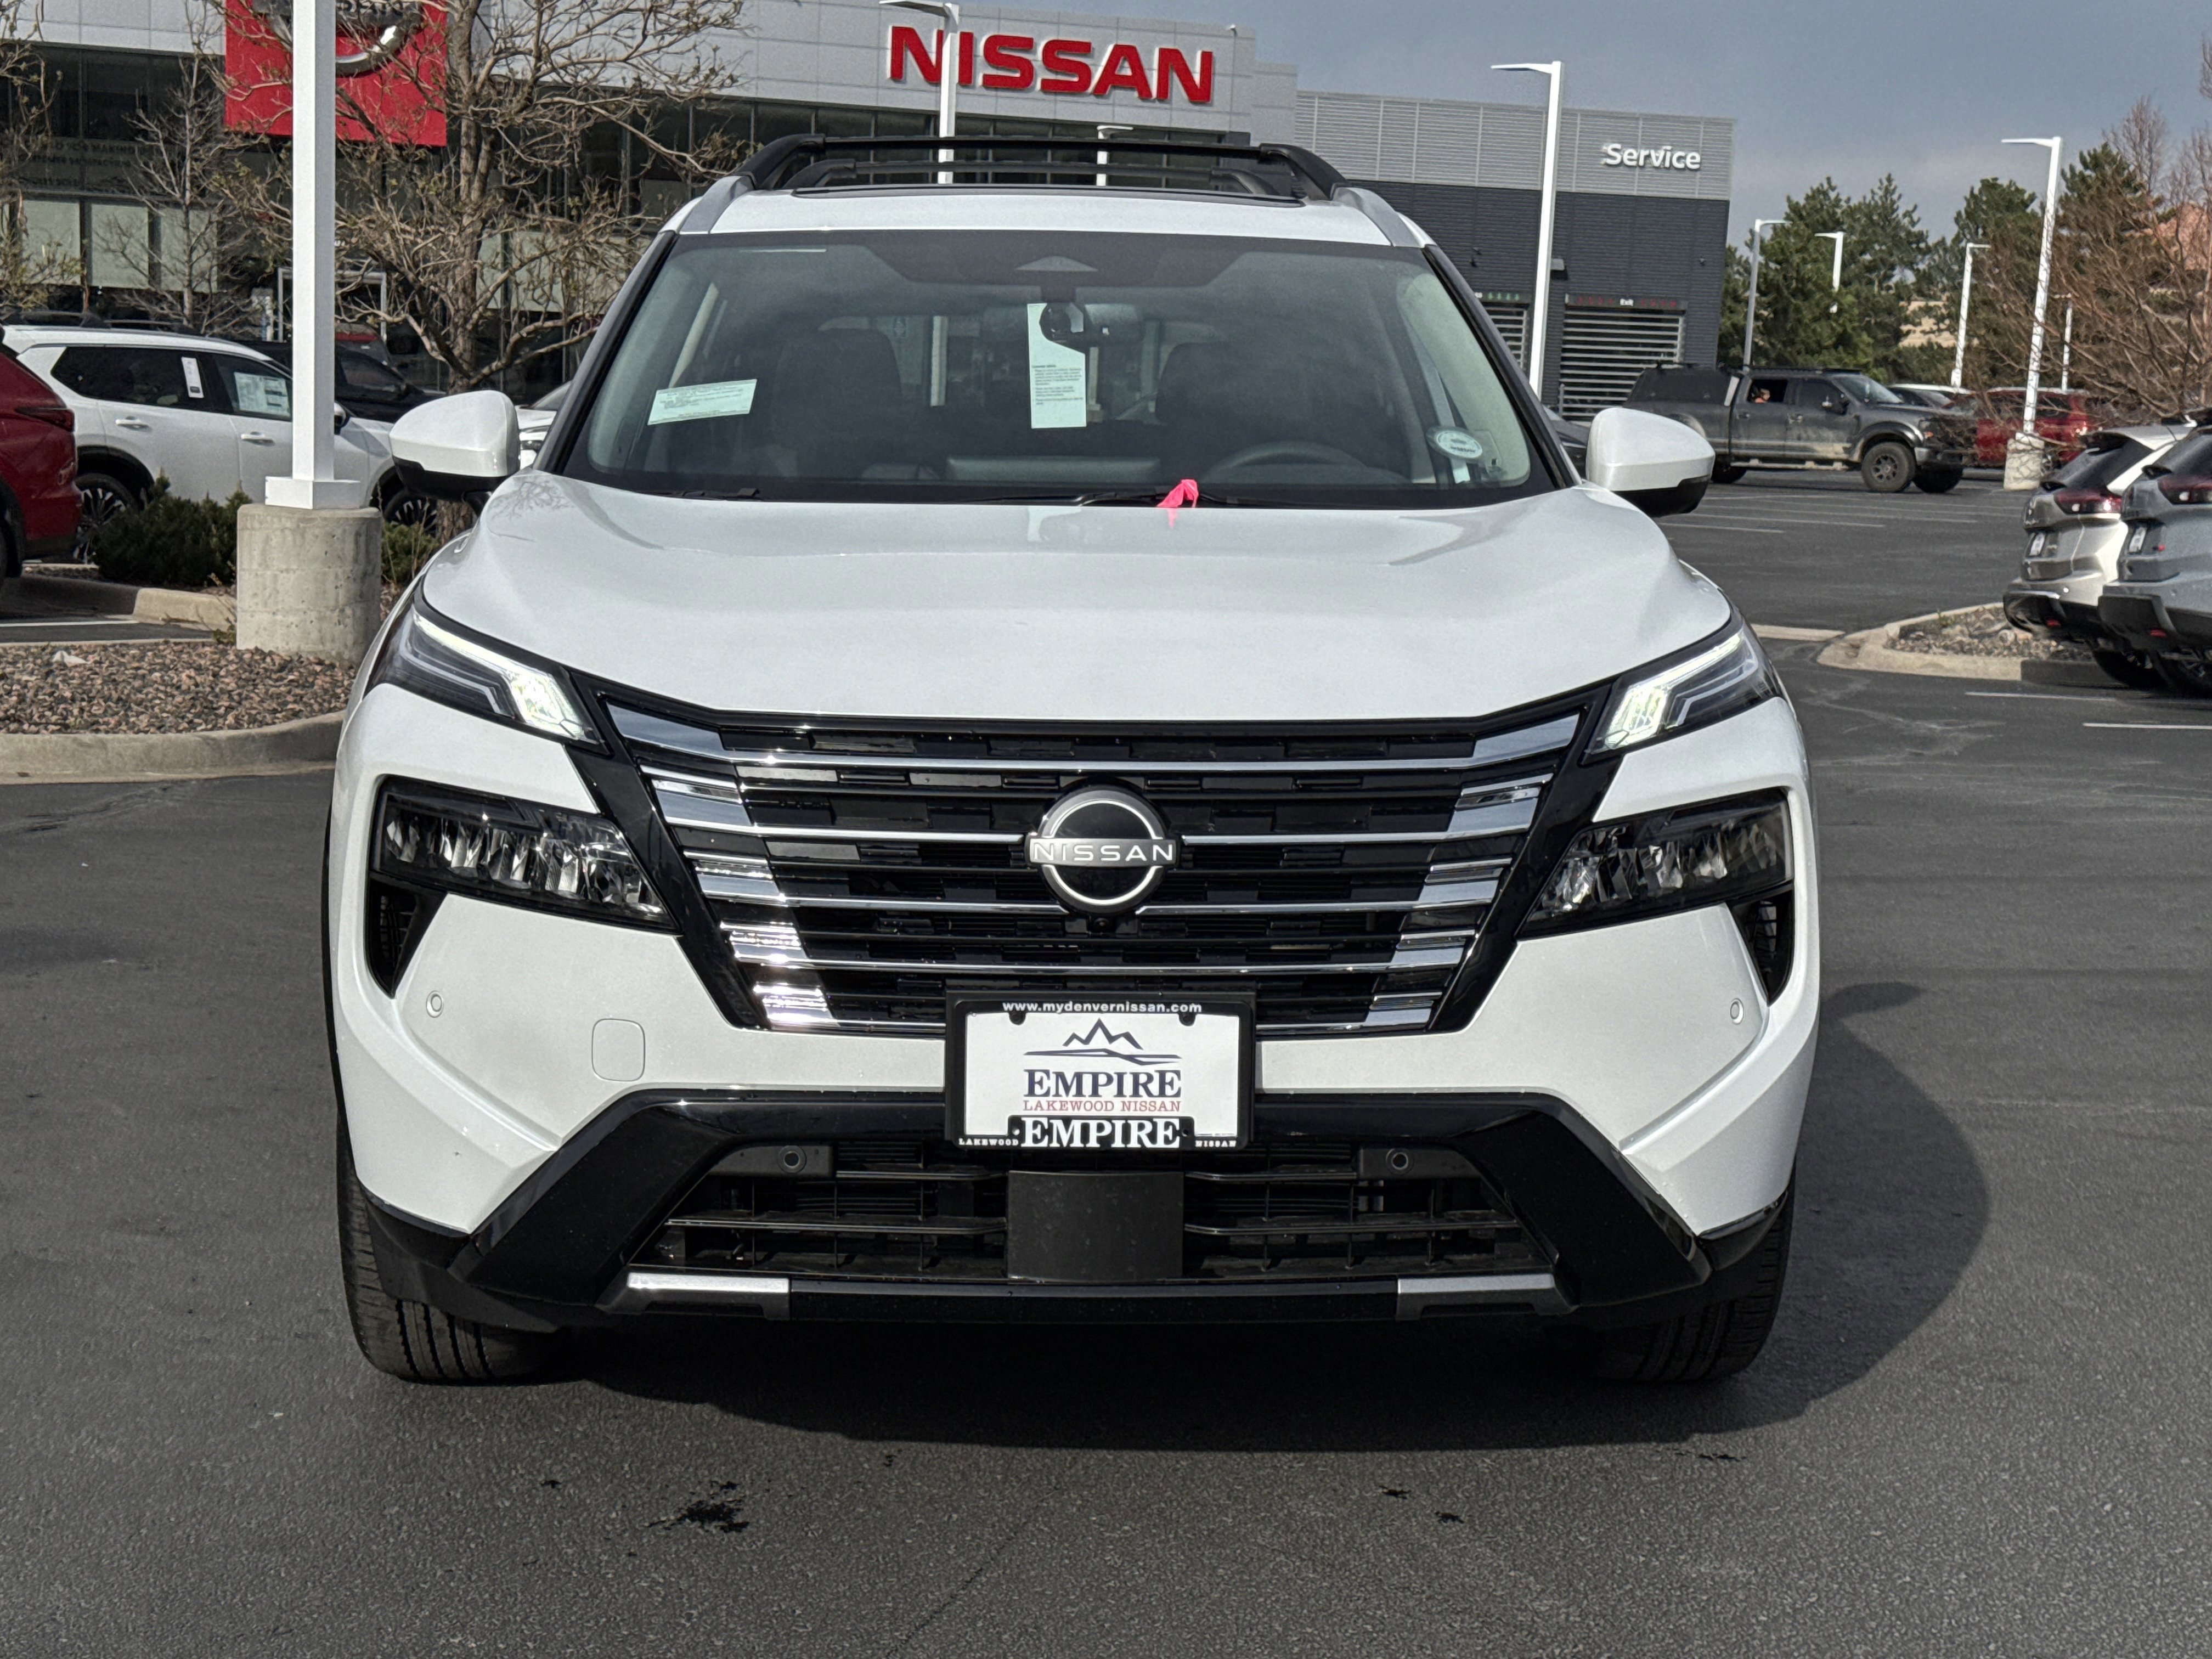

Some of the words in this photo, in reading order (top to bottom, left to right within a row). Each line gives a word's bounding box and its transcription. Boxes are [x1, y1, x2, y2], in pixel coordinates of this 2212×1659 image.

[889, 26, 1213, 102] NISSAN
[1606, 143, 1701, 170] Service
[1034, 843, 1173, 861] NISSAN
[1002, 1001, 1202, 1013] www.mydenvernissan.com
[1023, 1069, 1182, 1098] EMPIRE
[1023, 1100, 1115, 1112] LAKEWOOD
[1121, 1101, 1181, 1113] NISSAN
[958, 1138, 1019, 1146] LAKEWOOD
[1020, 1117, 1180, 1148] EMPIRE
